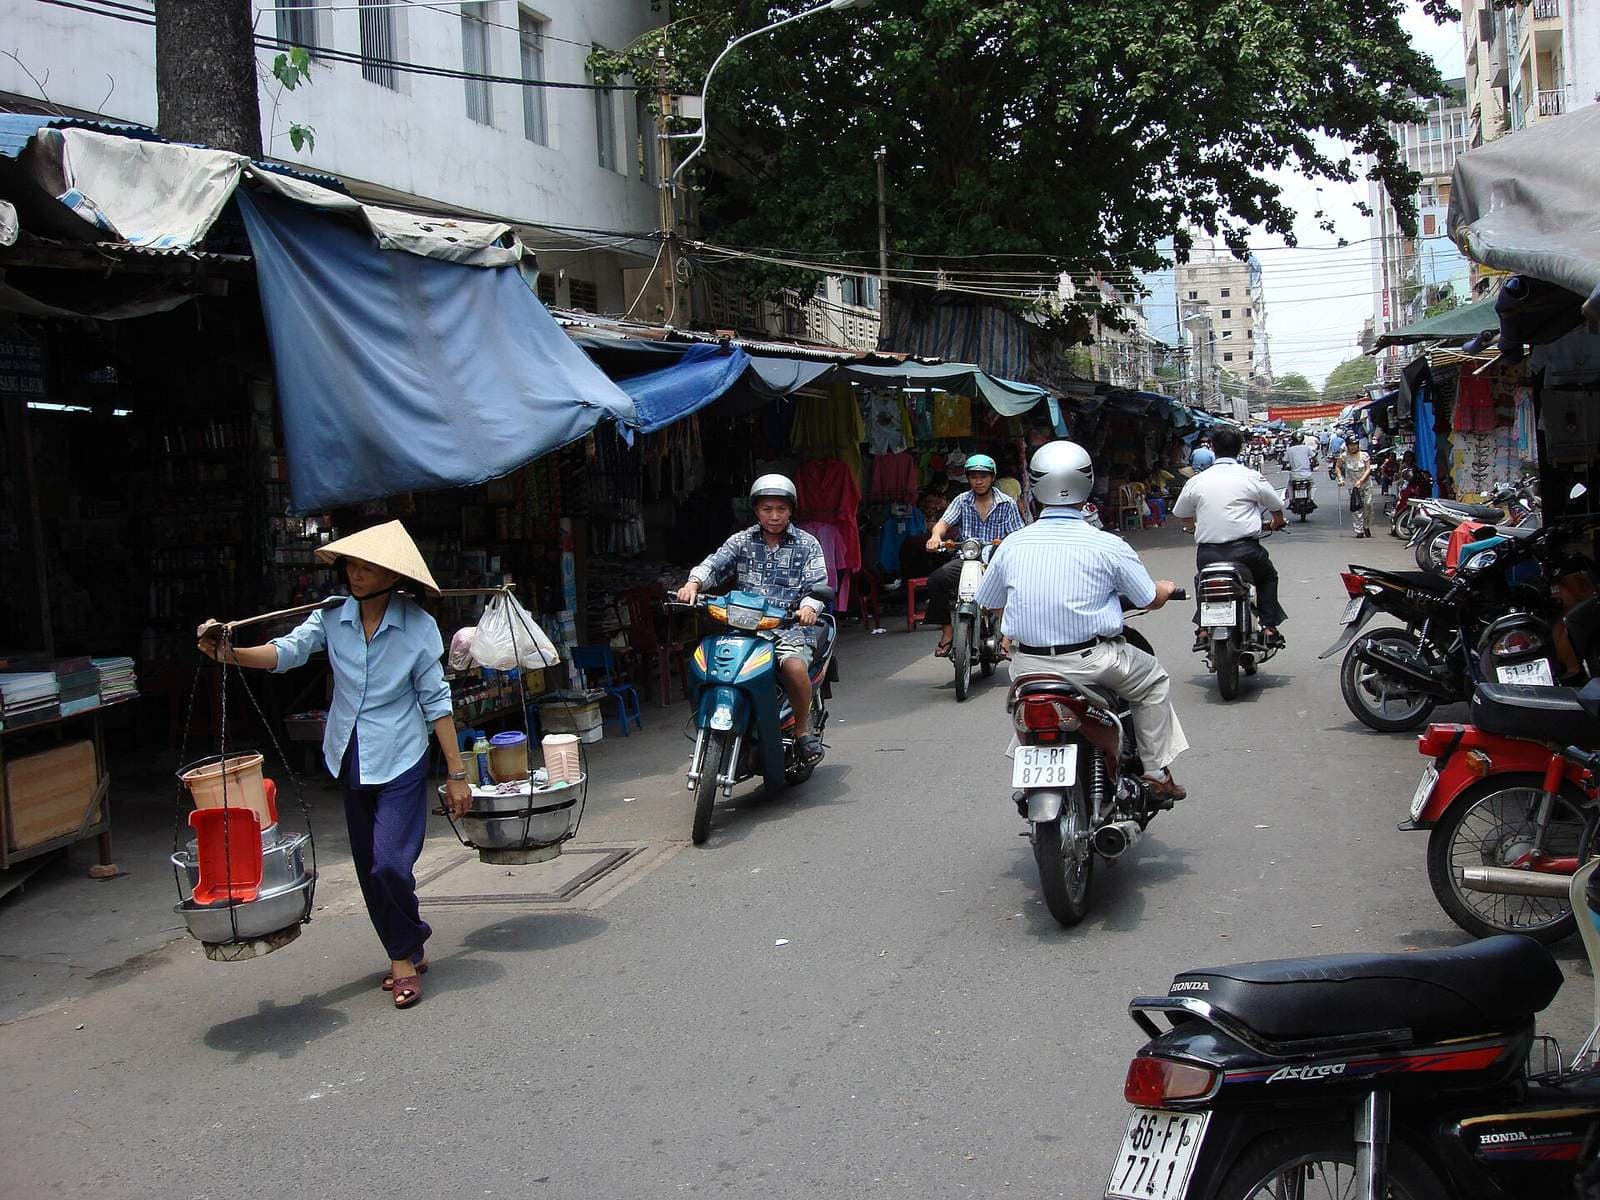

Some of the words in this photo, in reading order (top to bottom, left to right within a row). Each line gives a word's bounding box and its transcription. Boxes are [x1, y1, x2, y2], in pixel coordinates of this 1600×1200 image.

[1024, 747, 1065, 766] 51-R1
[1022, 766, 1066, 784] 8738
[1170, 981, 1210, 993] HONDA
[1265, 1063, 1347, 1085] Astrea
[1131, 1114, 1190, 1157] 66-F1
[1479, 1131, 1528, 1144] HONDA
